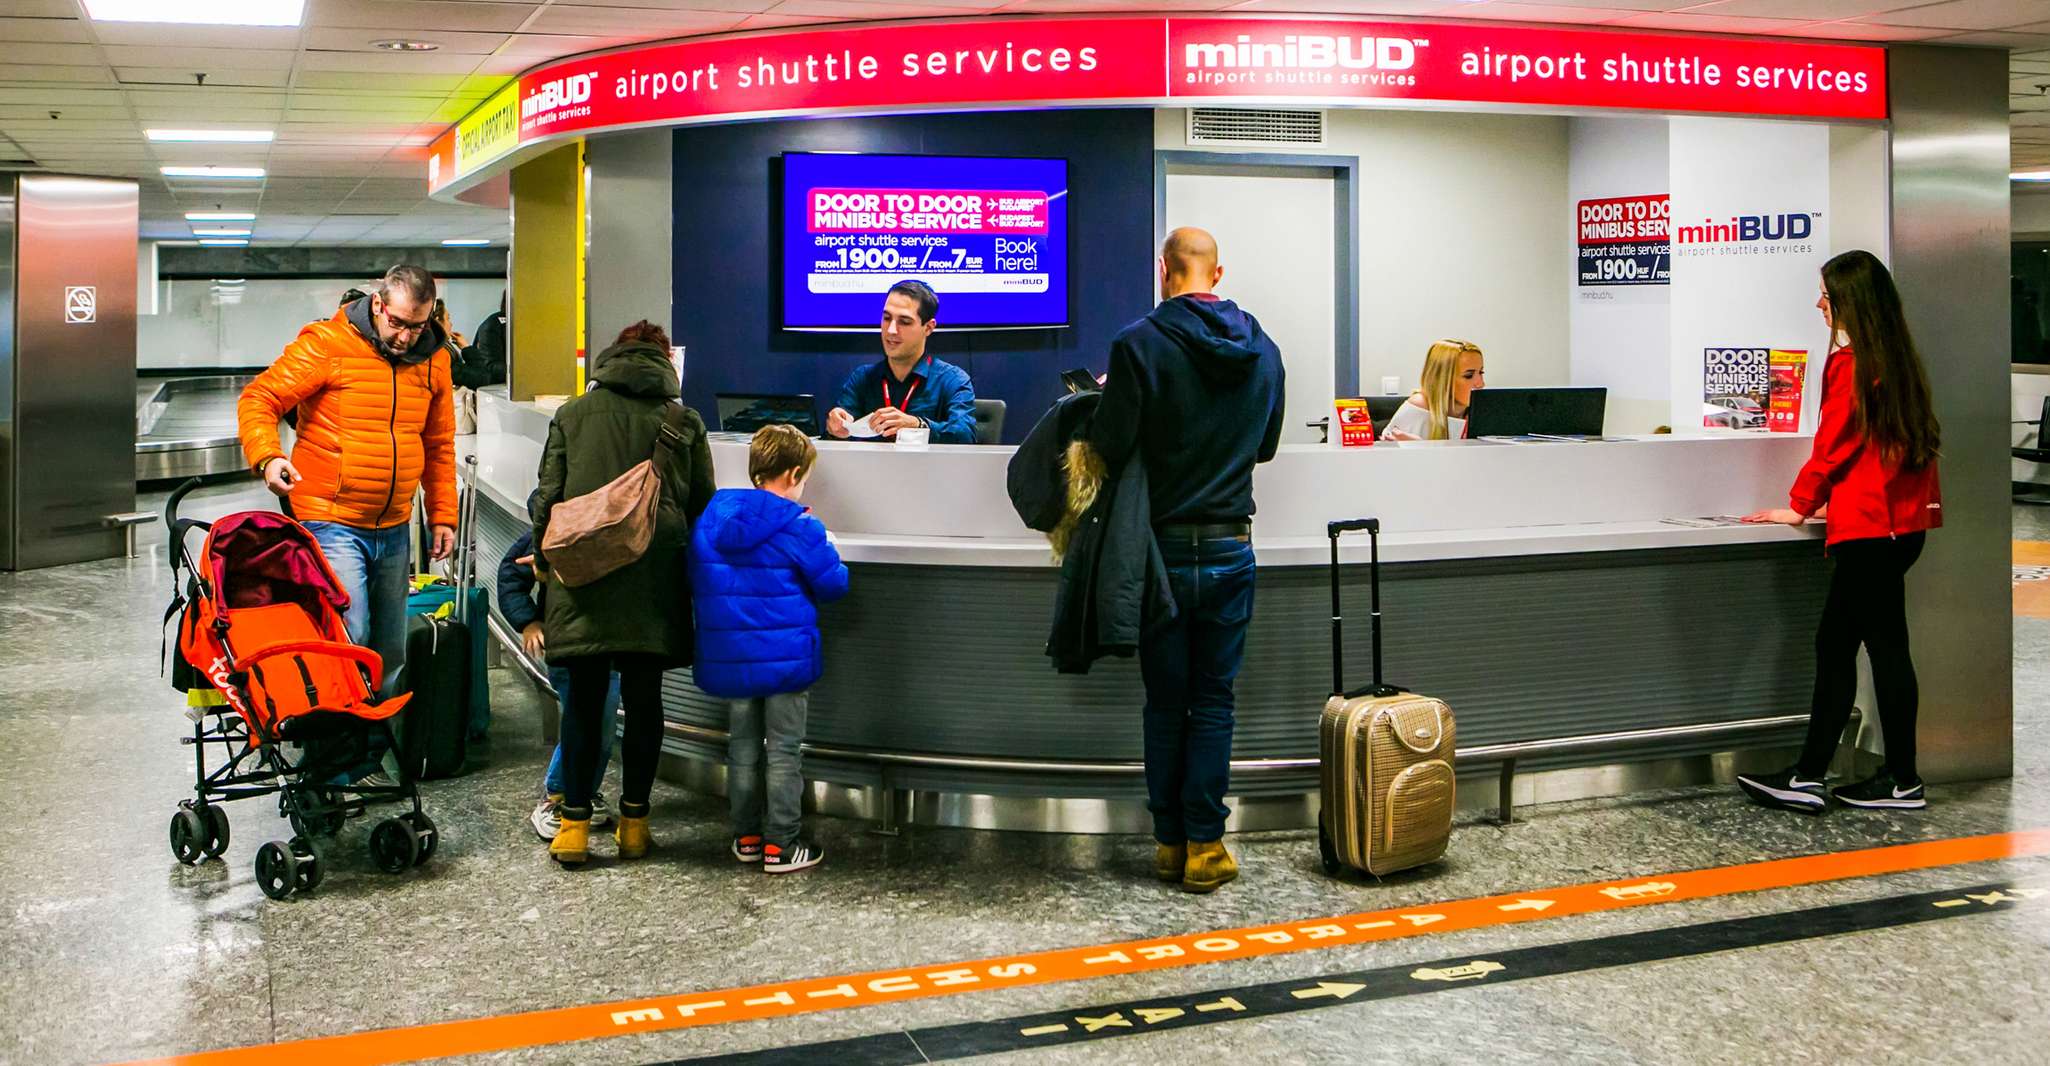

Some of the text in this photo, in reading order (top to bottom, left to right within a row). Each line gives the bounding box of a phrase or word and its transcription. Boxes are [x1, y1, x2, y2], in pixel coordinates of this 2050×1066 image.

[616, 41, 1098, 100] airport shuttle services
[1186, 69, 1416, 86] airport shuttle services
[1460, 46, 1869, 93] airport shuttle services
[558, 105, 591, 121] services
[814, 193, 982, 213] DOOR TO DOOR
[1581, 203, 1624, 223] DOOR
[1625, 201, 1647, 221] TO
[814, 212, 982, 230] MINIBUS SERVICE
[1581, 219, 1635, 240] MINIBUS
[814, 234, 948, 248] airport shuttle services
[994, 237, 1037, 254] Book
[815, 260, 840, 269] FROM
[837, 248, 899, 269] 1900
[928, 260, 953, 269] FROM
[951, 248, 966, 269] 7
[966, 257, 983, 265] EUR
[1581, 244, 1670, 259] airport shuttle services
[1678, 243, 1812, 257] airport shuttle services
[994, 254, 1038, 271] here!
[1595, 258, 1637, 280] 1900
[1705, 349, 1768, 365] DOOR
[1706, 364, 1768, 374] TO DOOR
[1706, 373, 1768, 384] MINIBUS
[1705, 383, 1768, 394] SERVICE
[610, 913, 1447, 1025] AIRPORT SHUTTLE
[1020, 996, 1246, 1036] TAXI
